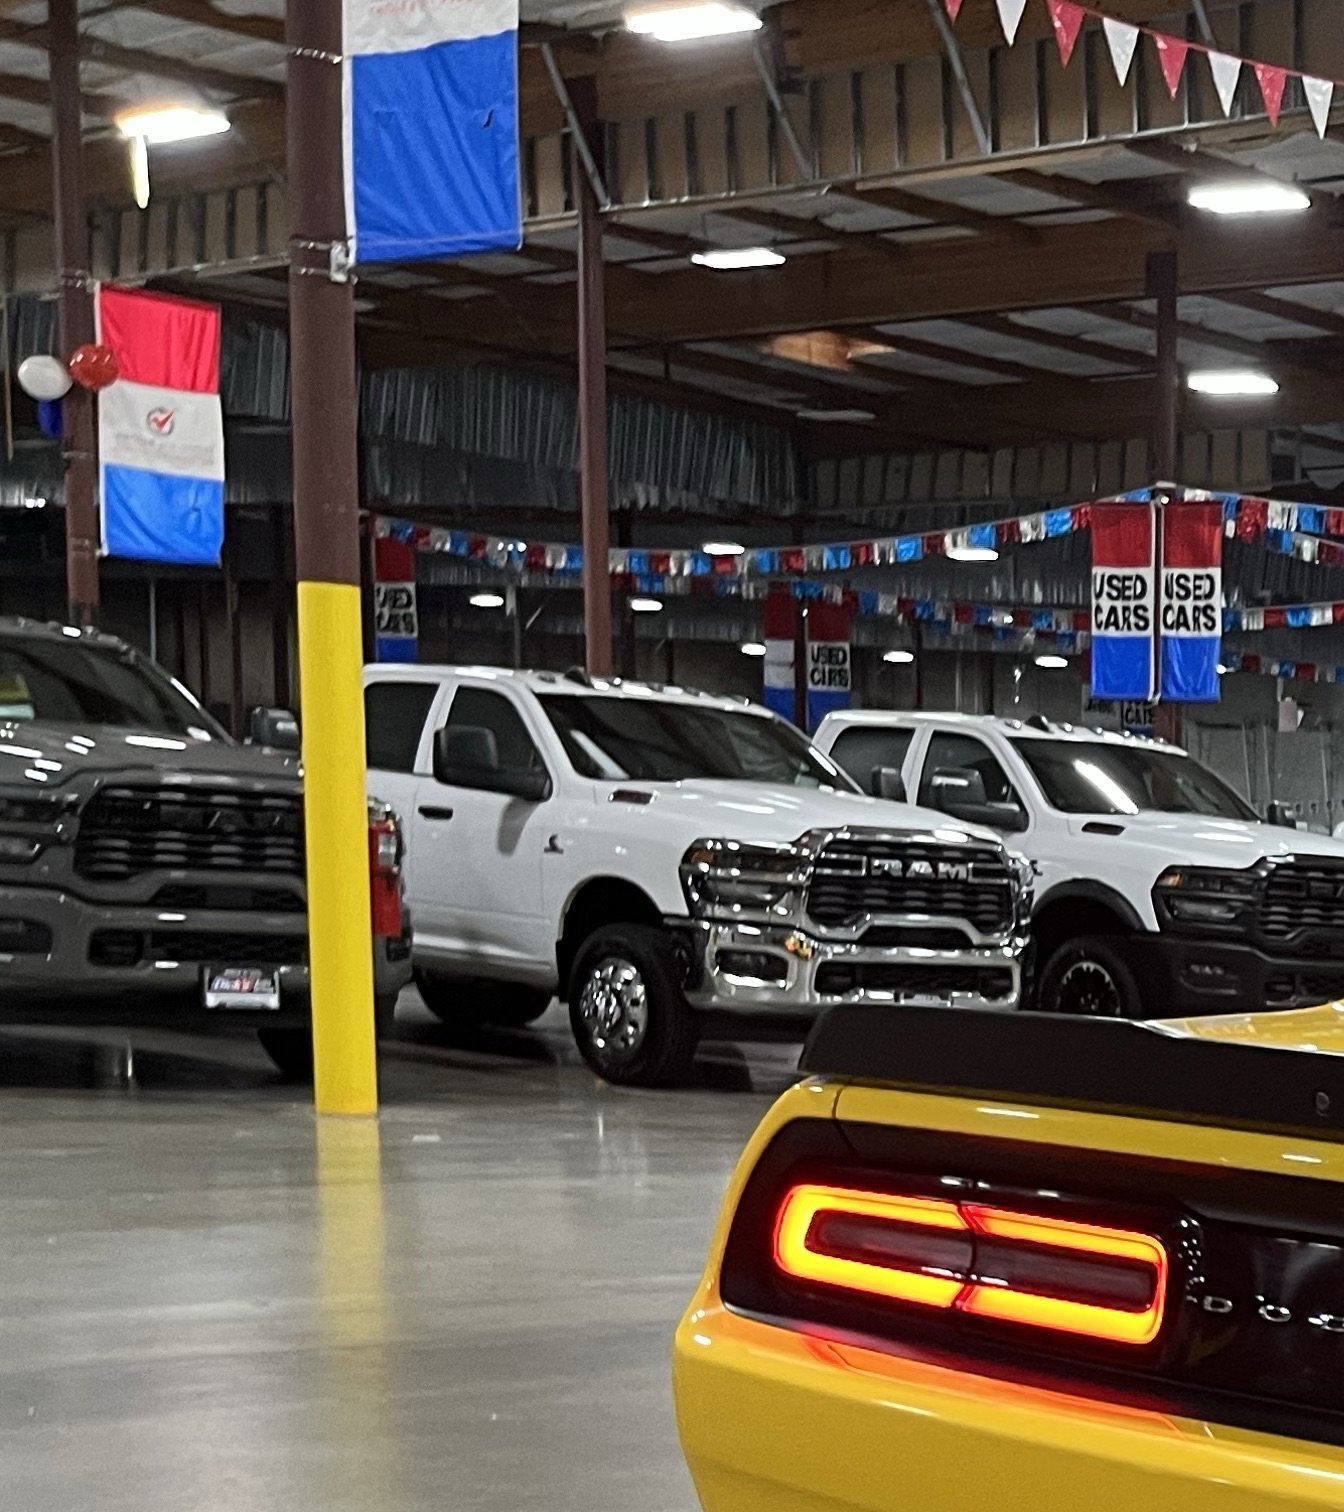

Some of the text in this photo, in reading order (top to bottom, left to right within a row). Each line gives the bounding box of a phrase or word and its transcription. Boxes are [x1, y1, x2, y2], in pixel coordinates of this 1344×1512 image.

[1093, 572, 1148, 601] USED
[1164, 572, 1216, 601] USED
[1094, 603, 1150, 632] CARS
[1162, 603, 1217, 632] CARS
[870, 858, 968, 881] RAM
